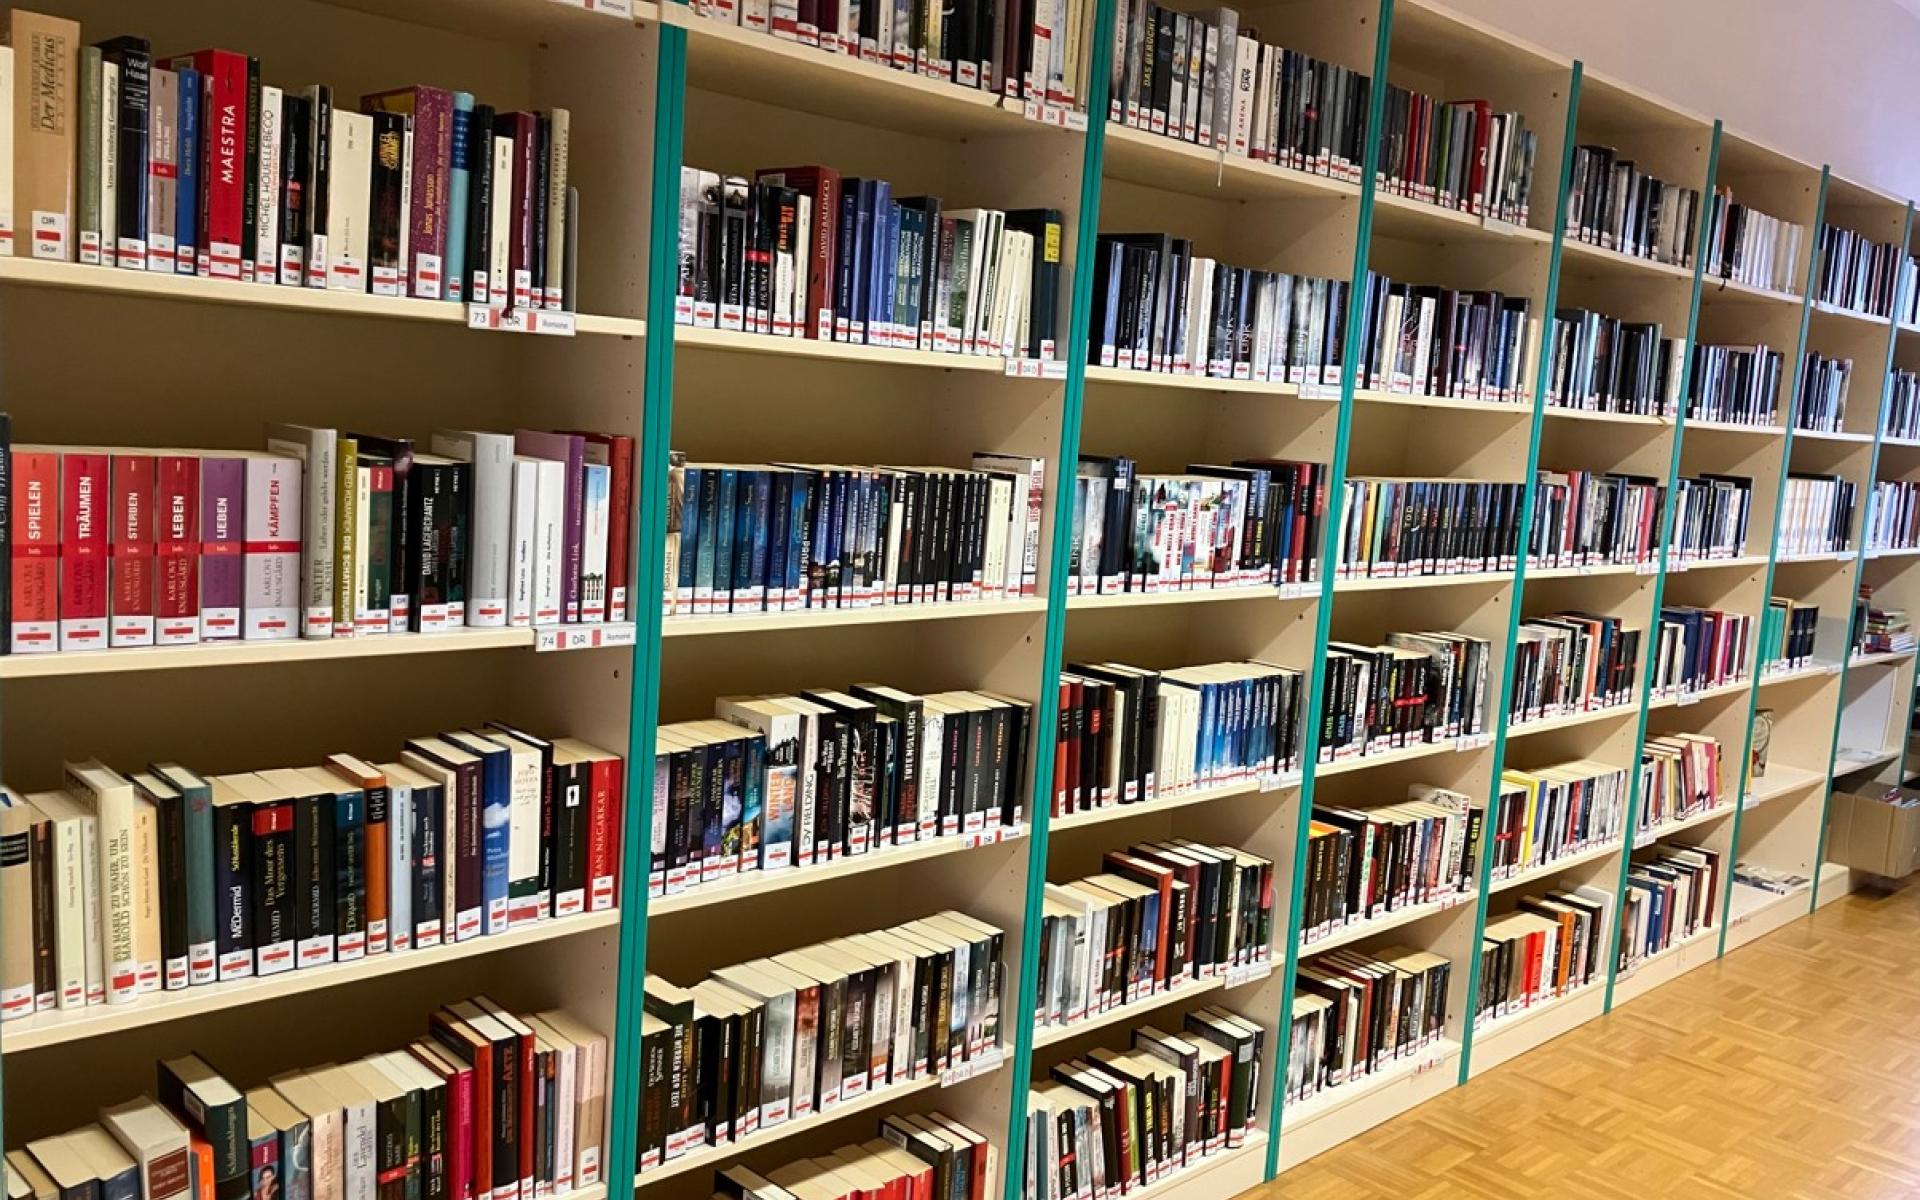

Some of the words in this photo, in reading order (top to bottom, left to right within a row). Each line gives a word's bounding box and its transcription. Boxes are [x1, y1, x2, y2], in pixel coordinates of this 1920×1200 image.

[40, 36, 57, 98] Medicus
[41, 104, 56, 131] Der
[220, 104, 236, 185] MAESTRA
[261, 110, 274, 193] HOUELLEBECQ
[260, 196, 270, 238] MICHEL
[473, 312, 486, 325] 73
[28, 480, 42, 541] SPIELEN
[77, 476, 92, 539] TRÄUMEN
[128, 492, 139, 541] STERBEN
[172, 495, 185, 539] LEBEN
[216, 497, 228, 539] LIEBEN
[268, 479, 284, 538] KÄMPFEN
[423, 497, 435, 551] LAGERCRANTZ
[422, 552, 432, 576] DAVID
[571, 543, 580, 561] Link
[312, 559, 324, 602] WALTER
[541, 635, 554, 647] 74
[571, 635, 587, 645] DR
[768, 771, 780, 821] WINTER
[803, 773, 814, 826] FIELDING
[119, 829, 128, 852] SEIN
[594, 790, 606, 852] NAGARKAR
[110, 838, 118, 856] UM
[119, 855, 128, 868] ZU
[264, 839, 273, 858] des
[118, 872, 130, 907] SCHÖN
[264, 860, 273, 885] Moor
[111, 894, 119, 909] ZU
[229, 885, 242, 938] McDermid
[264, 887, 274, 906] Das
[111, 912, 120, 943] MARIA
